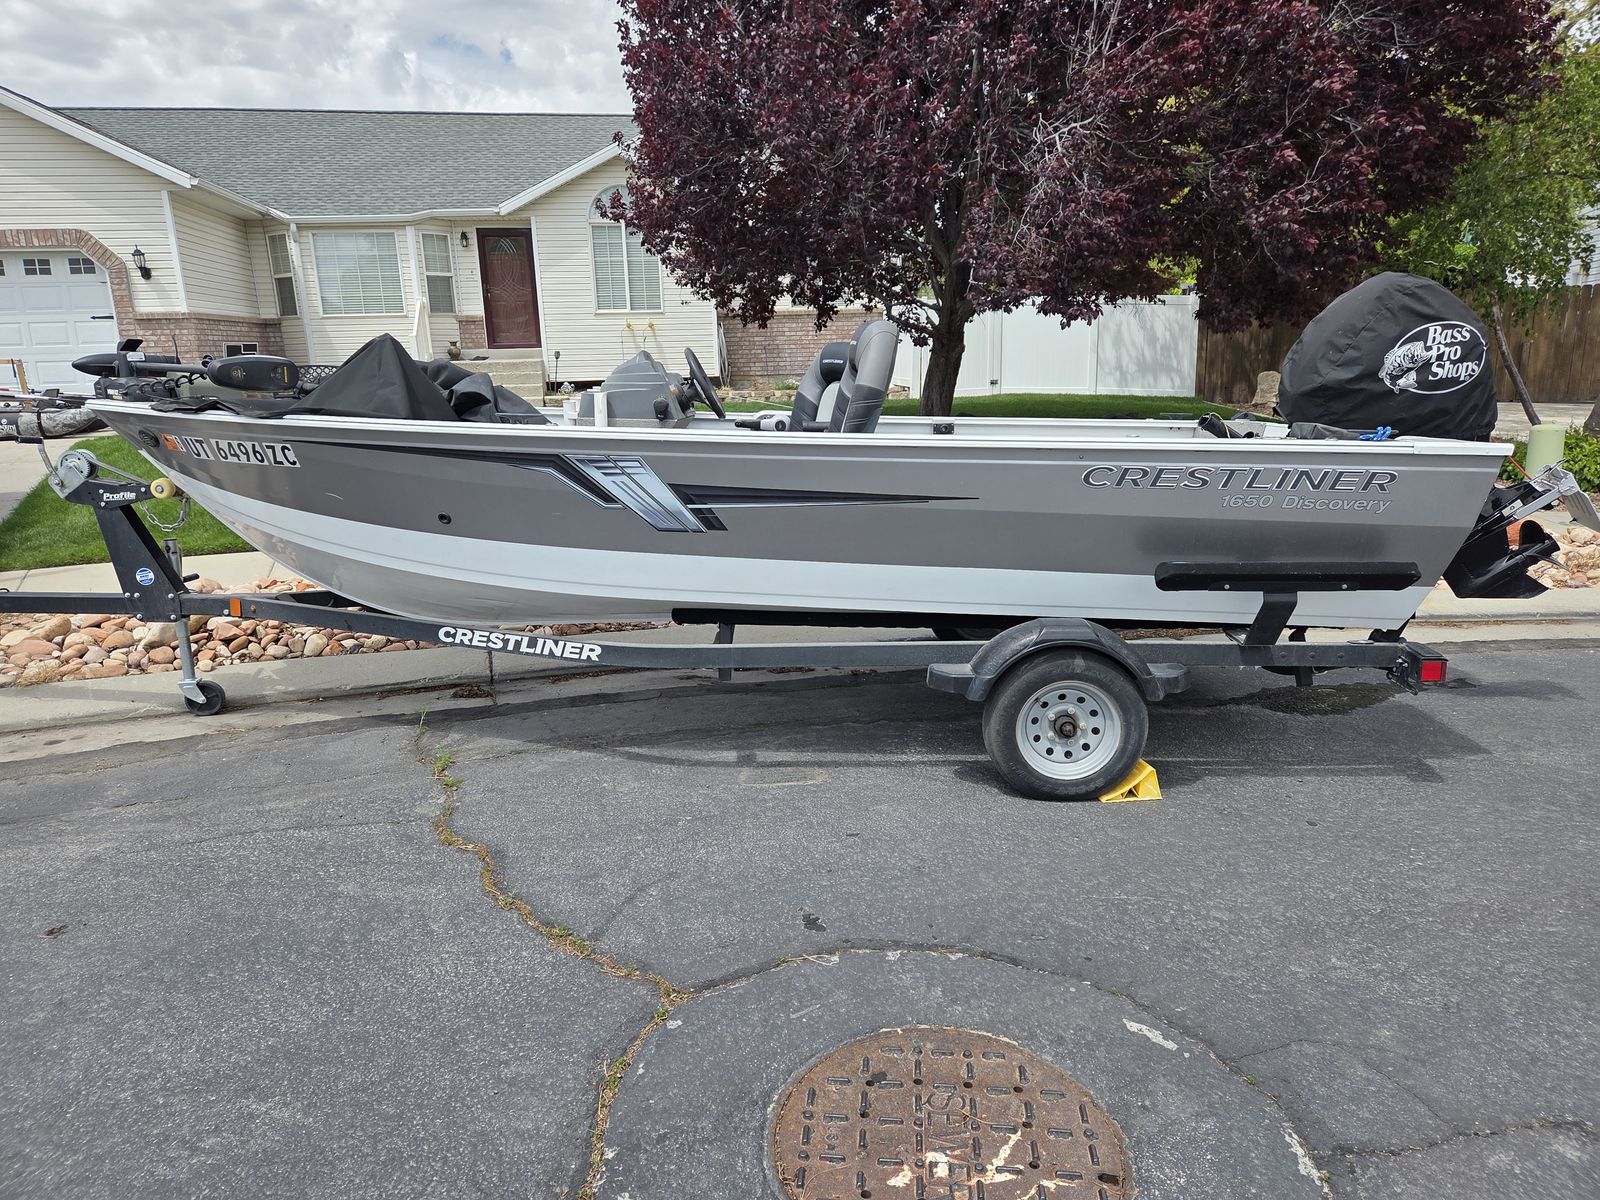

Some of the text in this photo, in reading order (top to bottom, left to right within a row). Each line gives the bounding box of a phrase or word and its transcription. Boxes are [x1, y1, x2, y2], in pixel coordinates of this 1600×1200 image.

[1426, 325, 1471, 346] Bass
[1429, 344, 1461, 363] Pro
[1428, 360, 1479, 381] Shops
[183, 437, 211, 459] UT
[215, 440, 265, 464] 6496
[265, 444, 298, 466] ZC
[1081, 464, 1400, 494] CRESTLINER
[103, 491, 136, 501] Profile
[1221, 494, 1393, 514] 1650 Discovery
[438, 626, 602, 662] CRESTLINER
